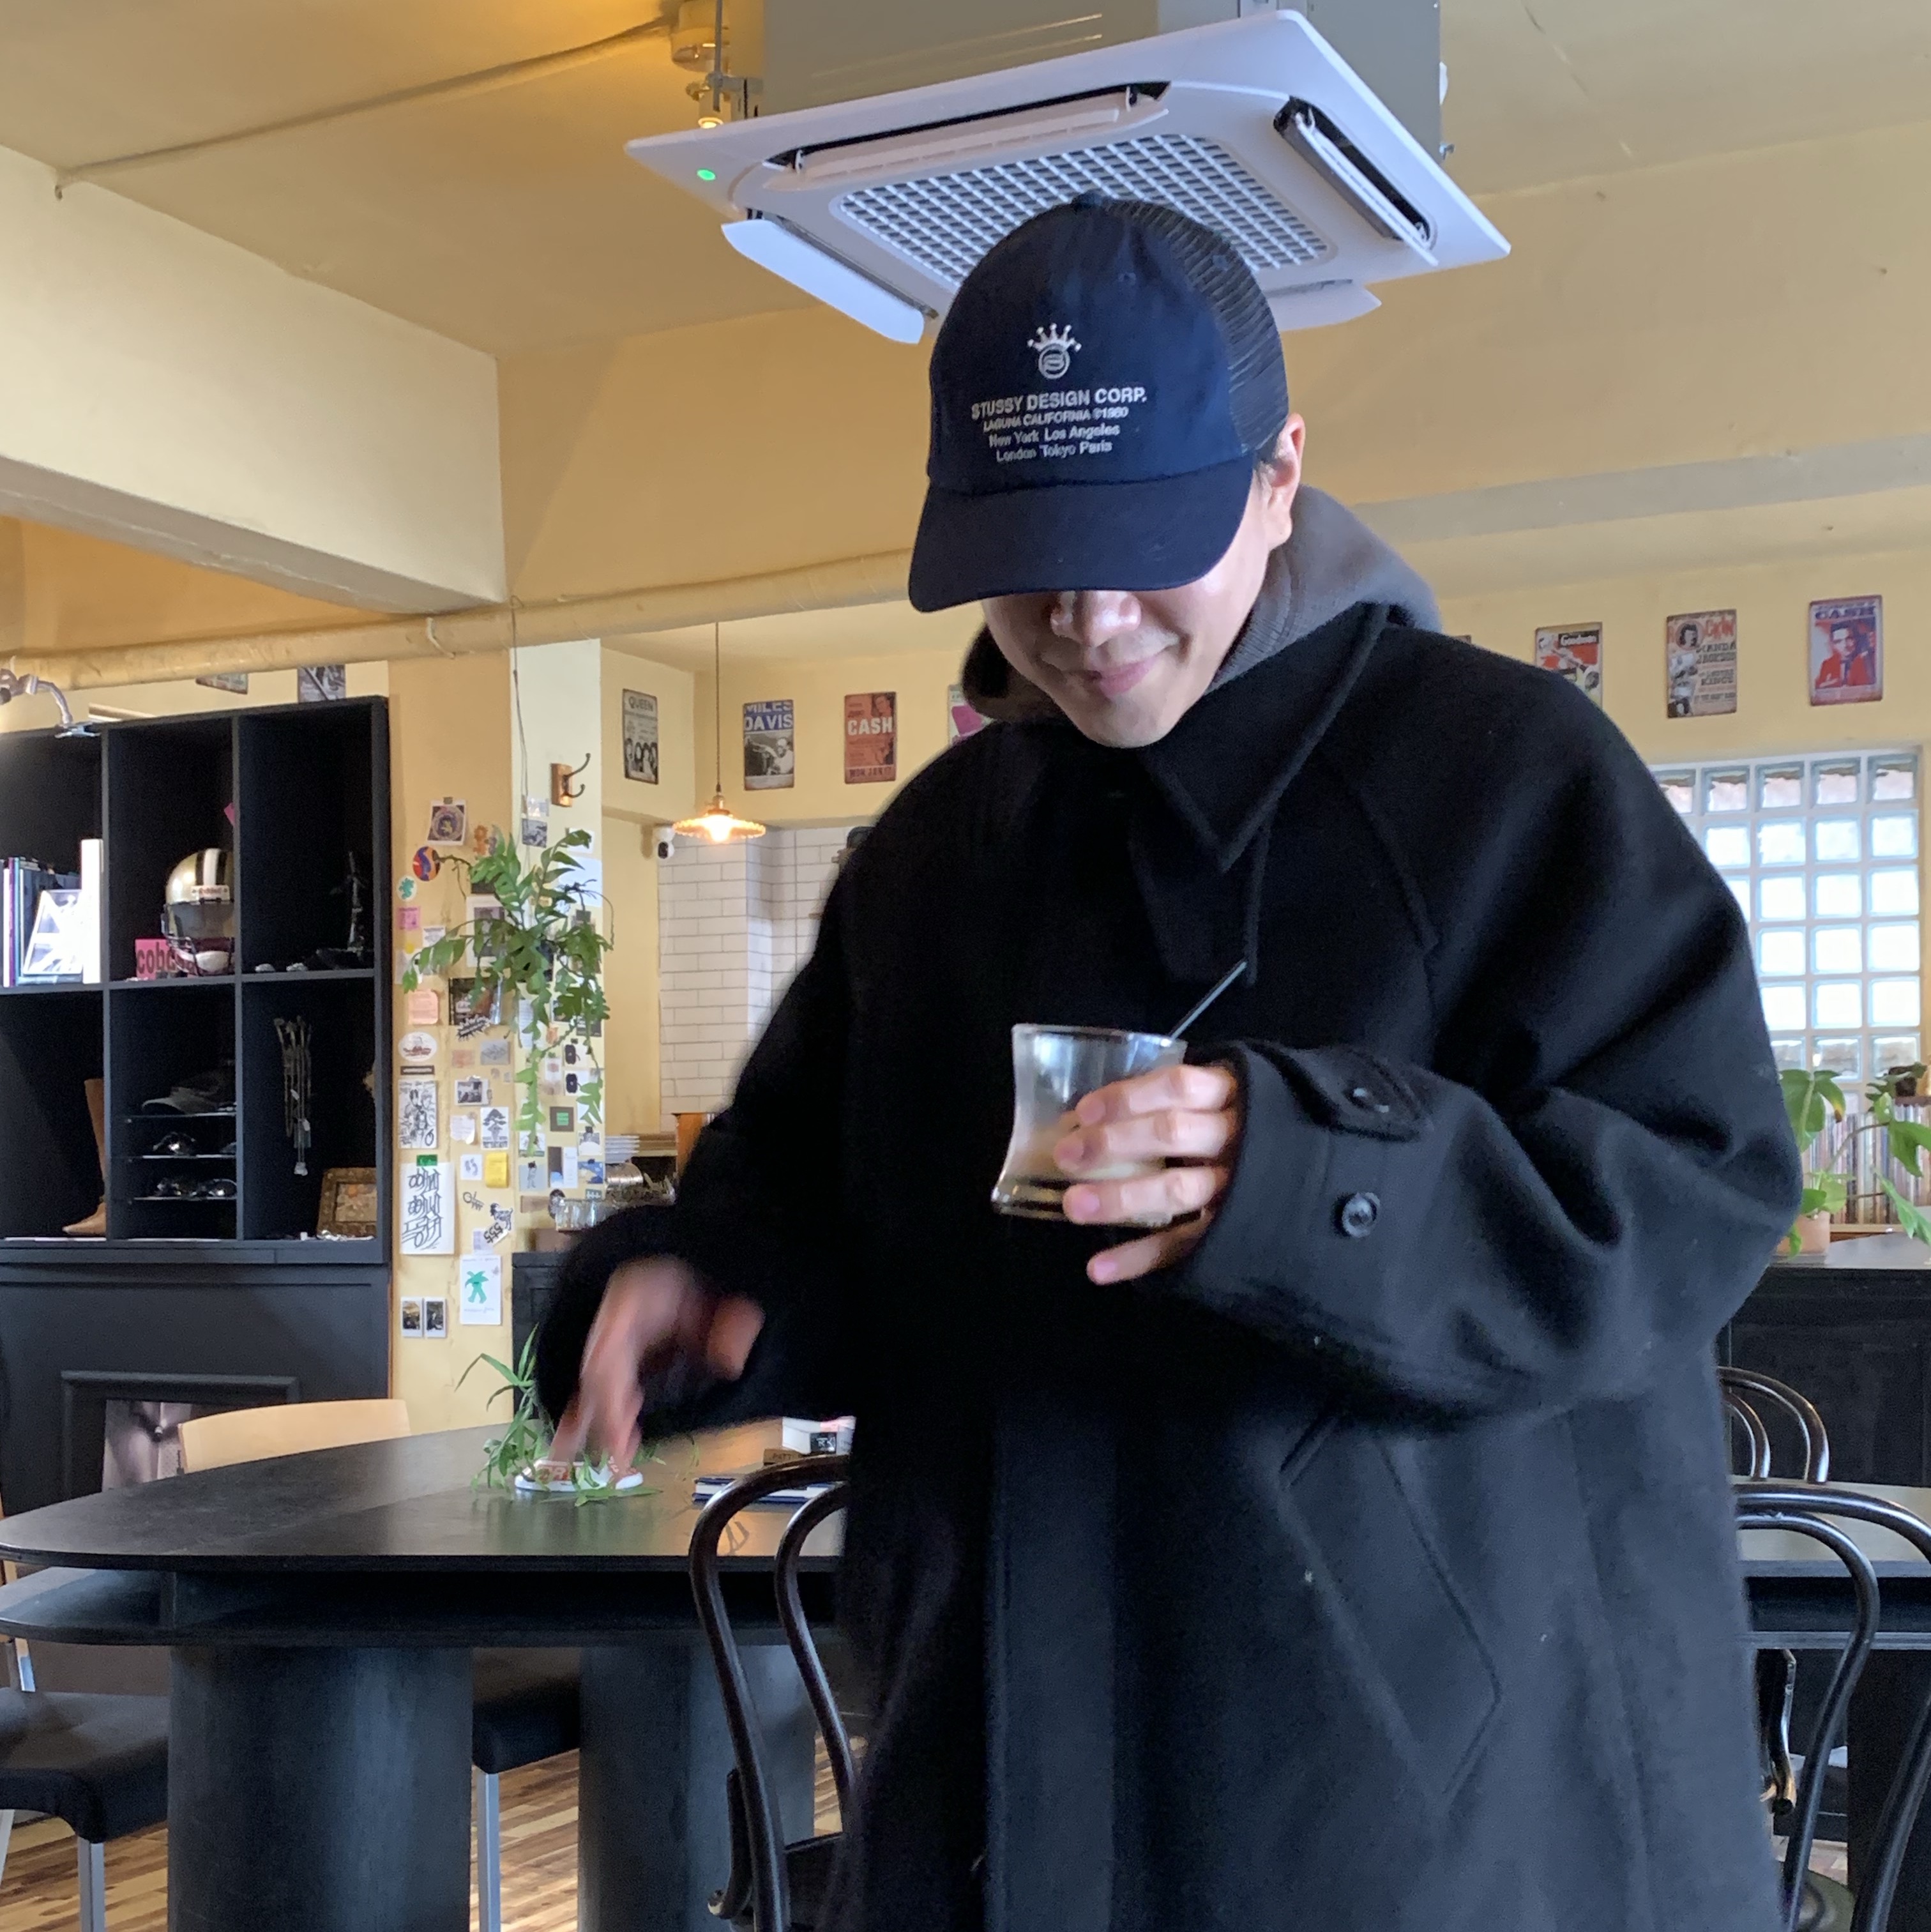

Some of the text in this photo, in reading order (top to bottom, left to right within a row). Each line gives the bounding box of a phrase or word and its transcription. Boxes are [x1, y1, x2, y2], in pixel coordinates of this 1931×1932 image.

[971, 387, 1147, 420] STUSSY DESIGN CORP.
[983, 418, 1022, 432] LAGUNA
[1023, 410, 1091, 426] CALIFORNIA
[989, 423, 1120, 448] New York Los Angeles
[996, 440, 1113, 462] London Tokyo Paris
[628, 696, 653, 711] QUEEN
[746, 701, 792, 713] MILES
[745, 714, 792, 731] DAVIS
[847, 716, 893, 735] CASH
